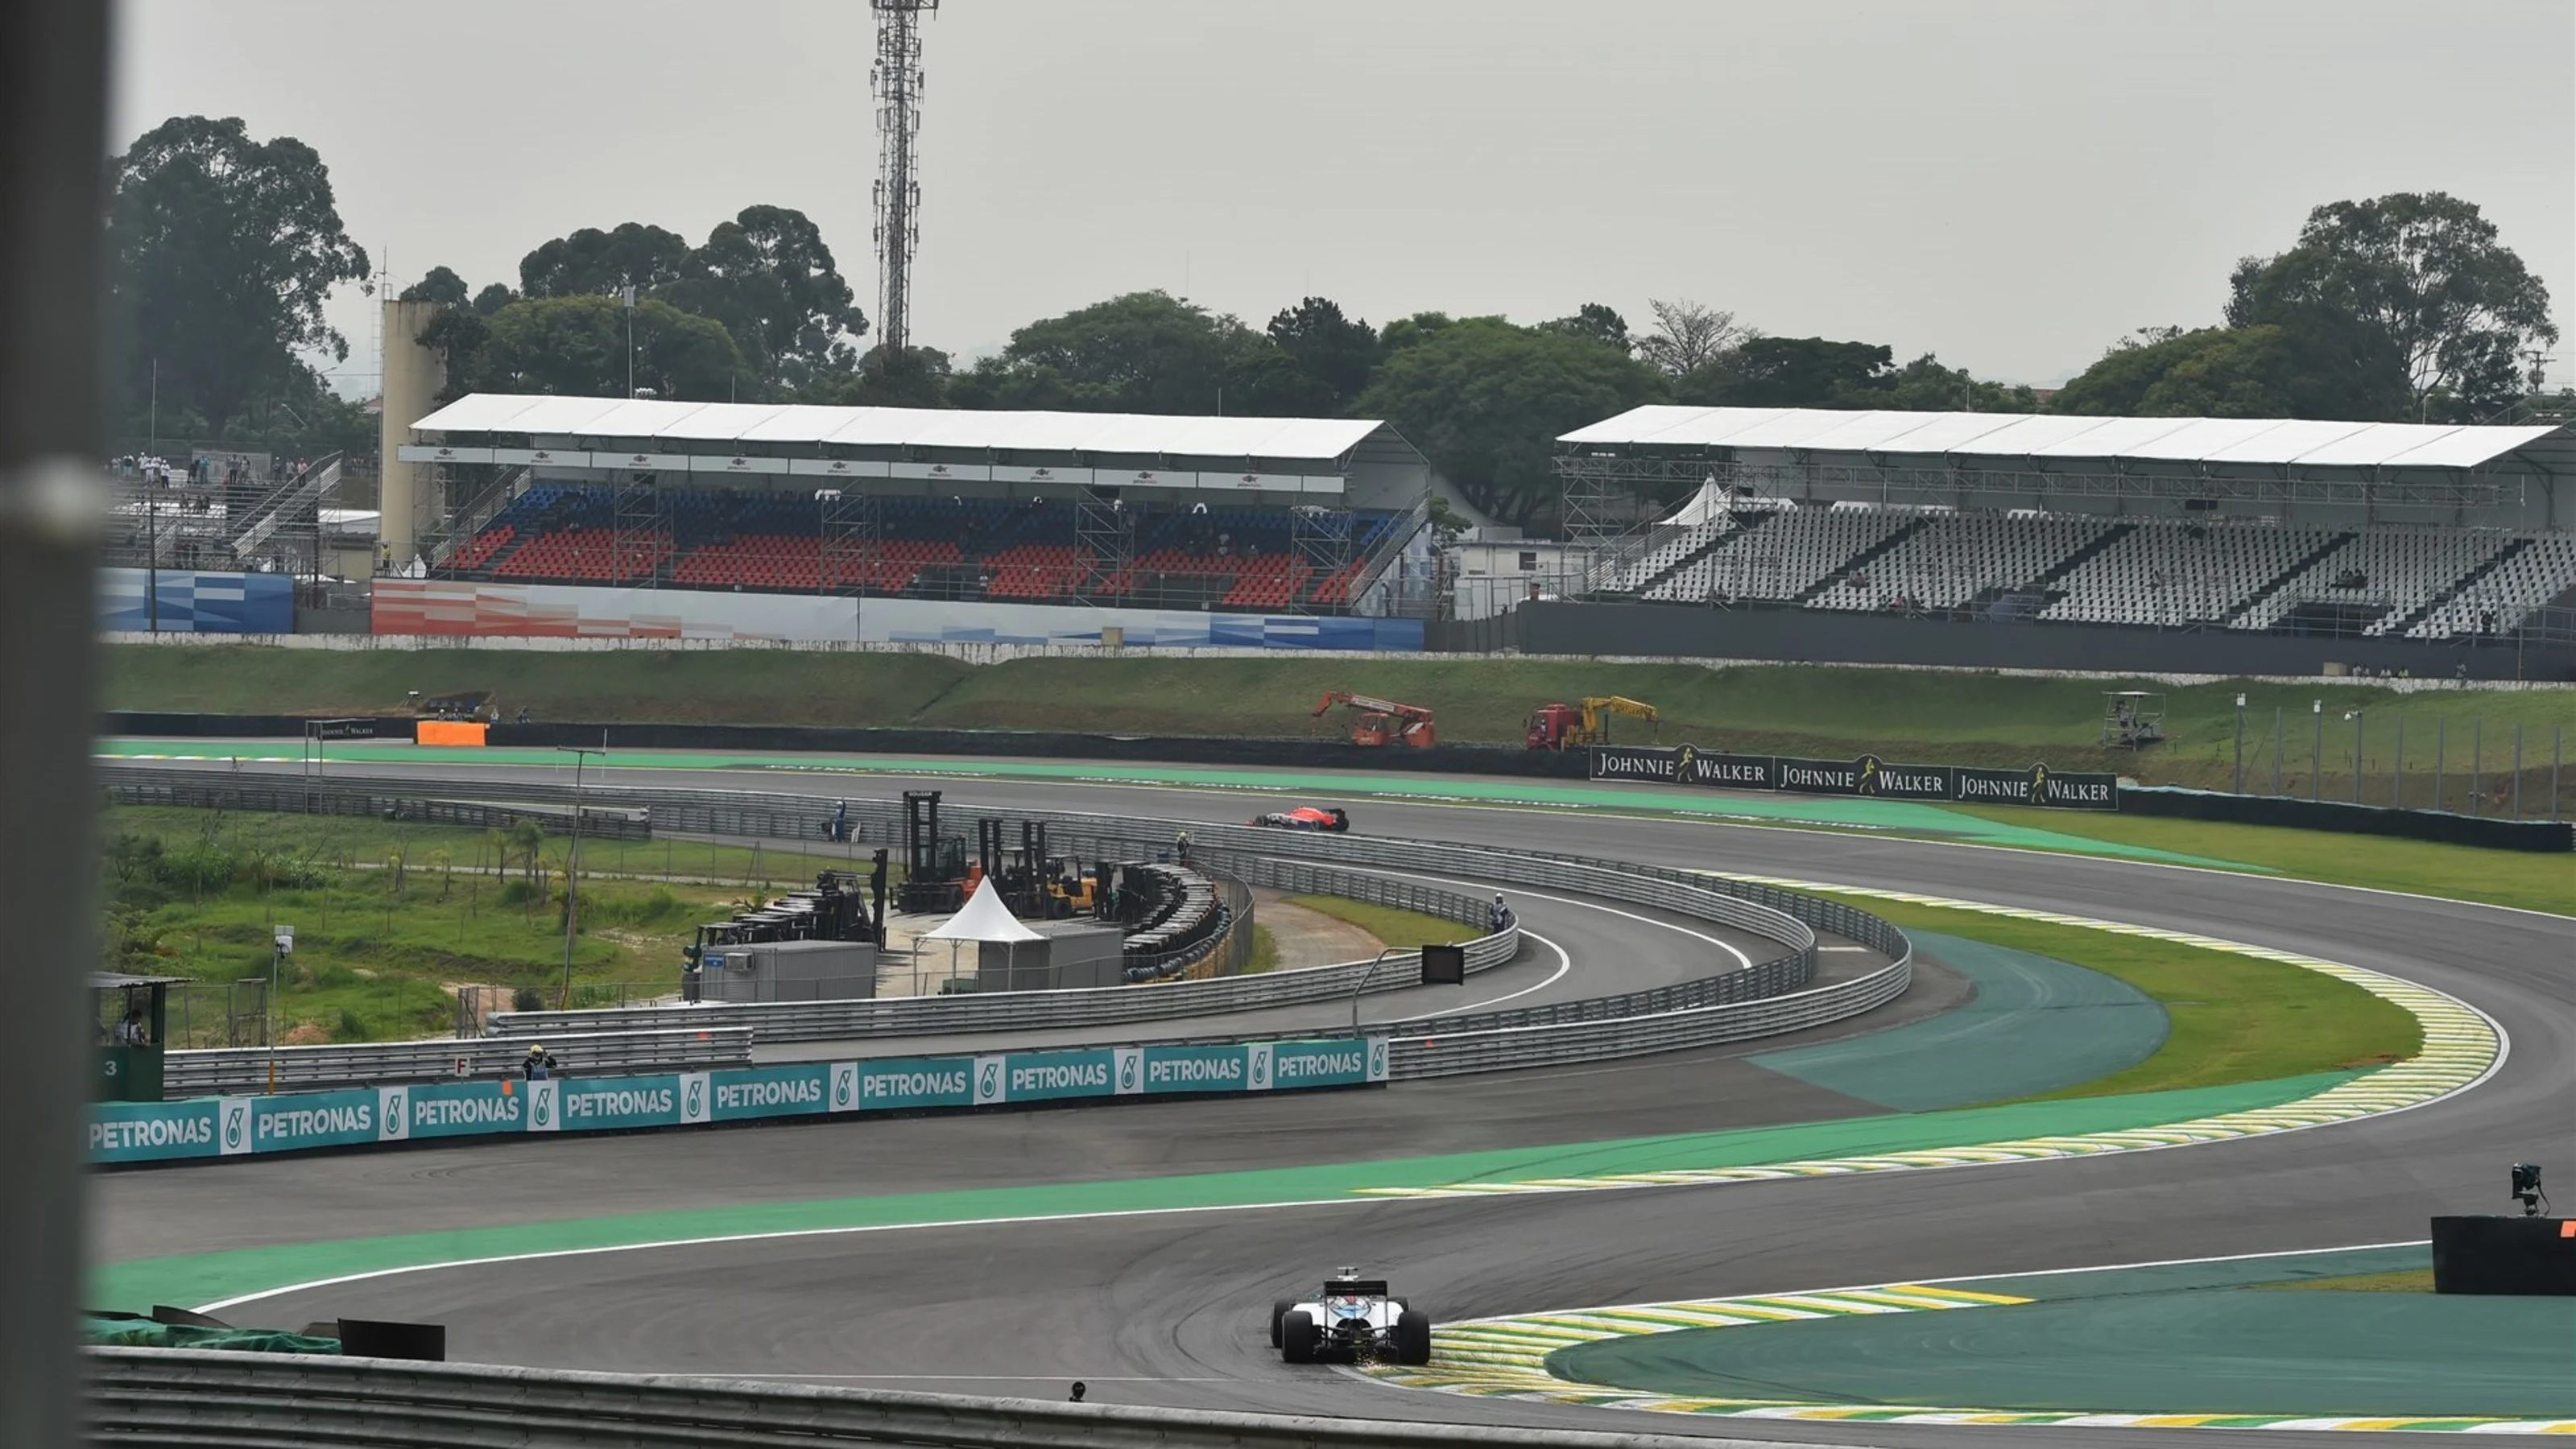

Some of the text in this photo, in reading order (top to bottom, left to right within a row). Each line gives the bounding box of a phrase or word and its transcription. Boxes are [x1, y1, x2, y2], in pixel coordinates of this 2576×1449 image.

[1598, 753, 1764, 781] JOHNNIE WALKER
[1780, 765, 1942, 791] JOHNNIE WALKER
[1958, 775, 2108, 800] JOHNNIE WALKER
[105, 1061, 117, 1075] 3
[457, 1059, 467, 1075] F
[1012, 1063, 1107, 1090] PETRONAS
[1149, 1059, 1240, 1082] PETRONAS
[1278, 1052, 1362, 1077] PETRONAS
[717, 1079, 821, 1108] PETRONAS
[864, 1071, 965, 1097] PETRONAS
[416, 1096, 519, 1125] PETRONAS
[567, 1088, 672, 1117] PETRONAS
[89, 1117, 212, 1150] PETRONAS
[258, 1105, 371, 1139] PETRONAS
